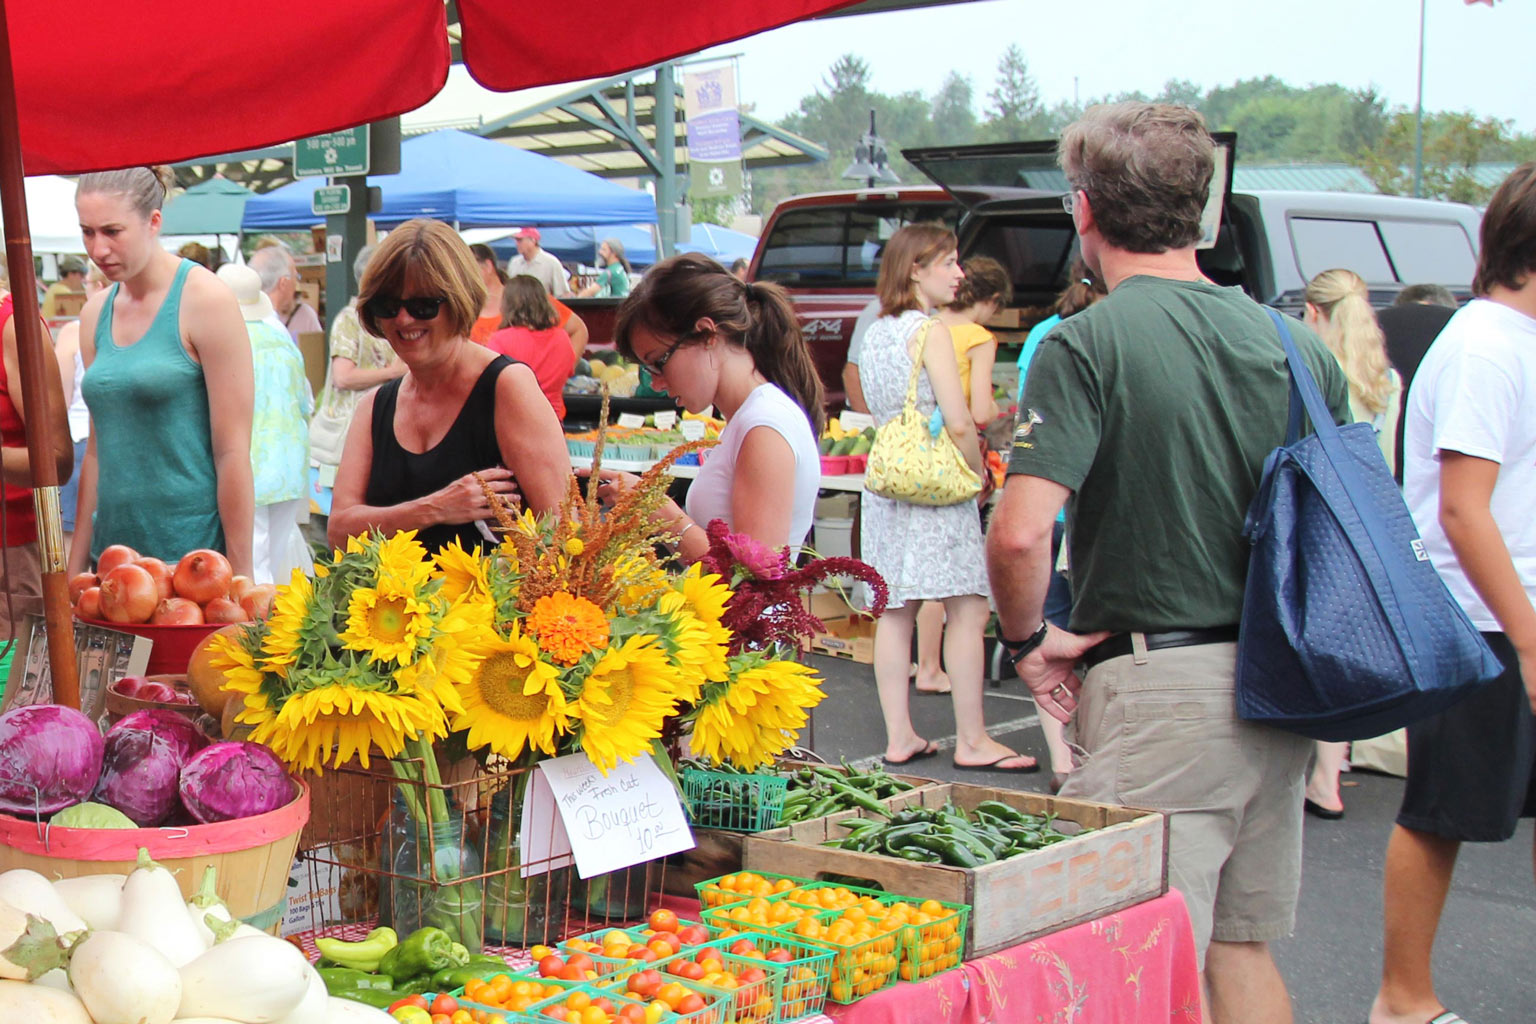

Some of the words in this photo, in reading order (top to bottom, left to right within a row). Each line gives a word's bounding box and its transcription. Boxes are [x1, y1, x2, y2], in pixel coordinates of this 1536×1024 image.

[588, 785, 618, 801] Fresh
[620, 773, 640, 793] Cut
[575, 792, 664, 840] Bouquet
[990, 834, 1153, 929] PEPSI
[289, 895, 307, 906] Twist
[289, 915, 305, 924] Gallon
